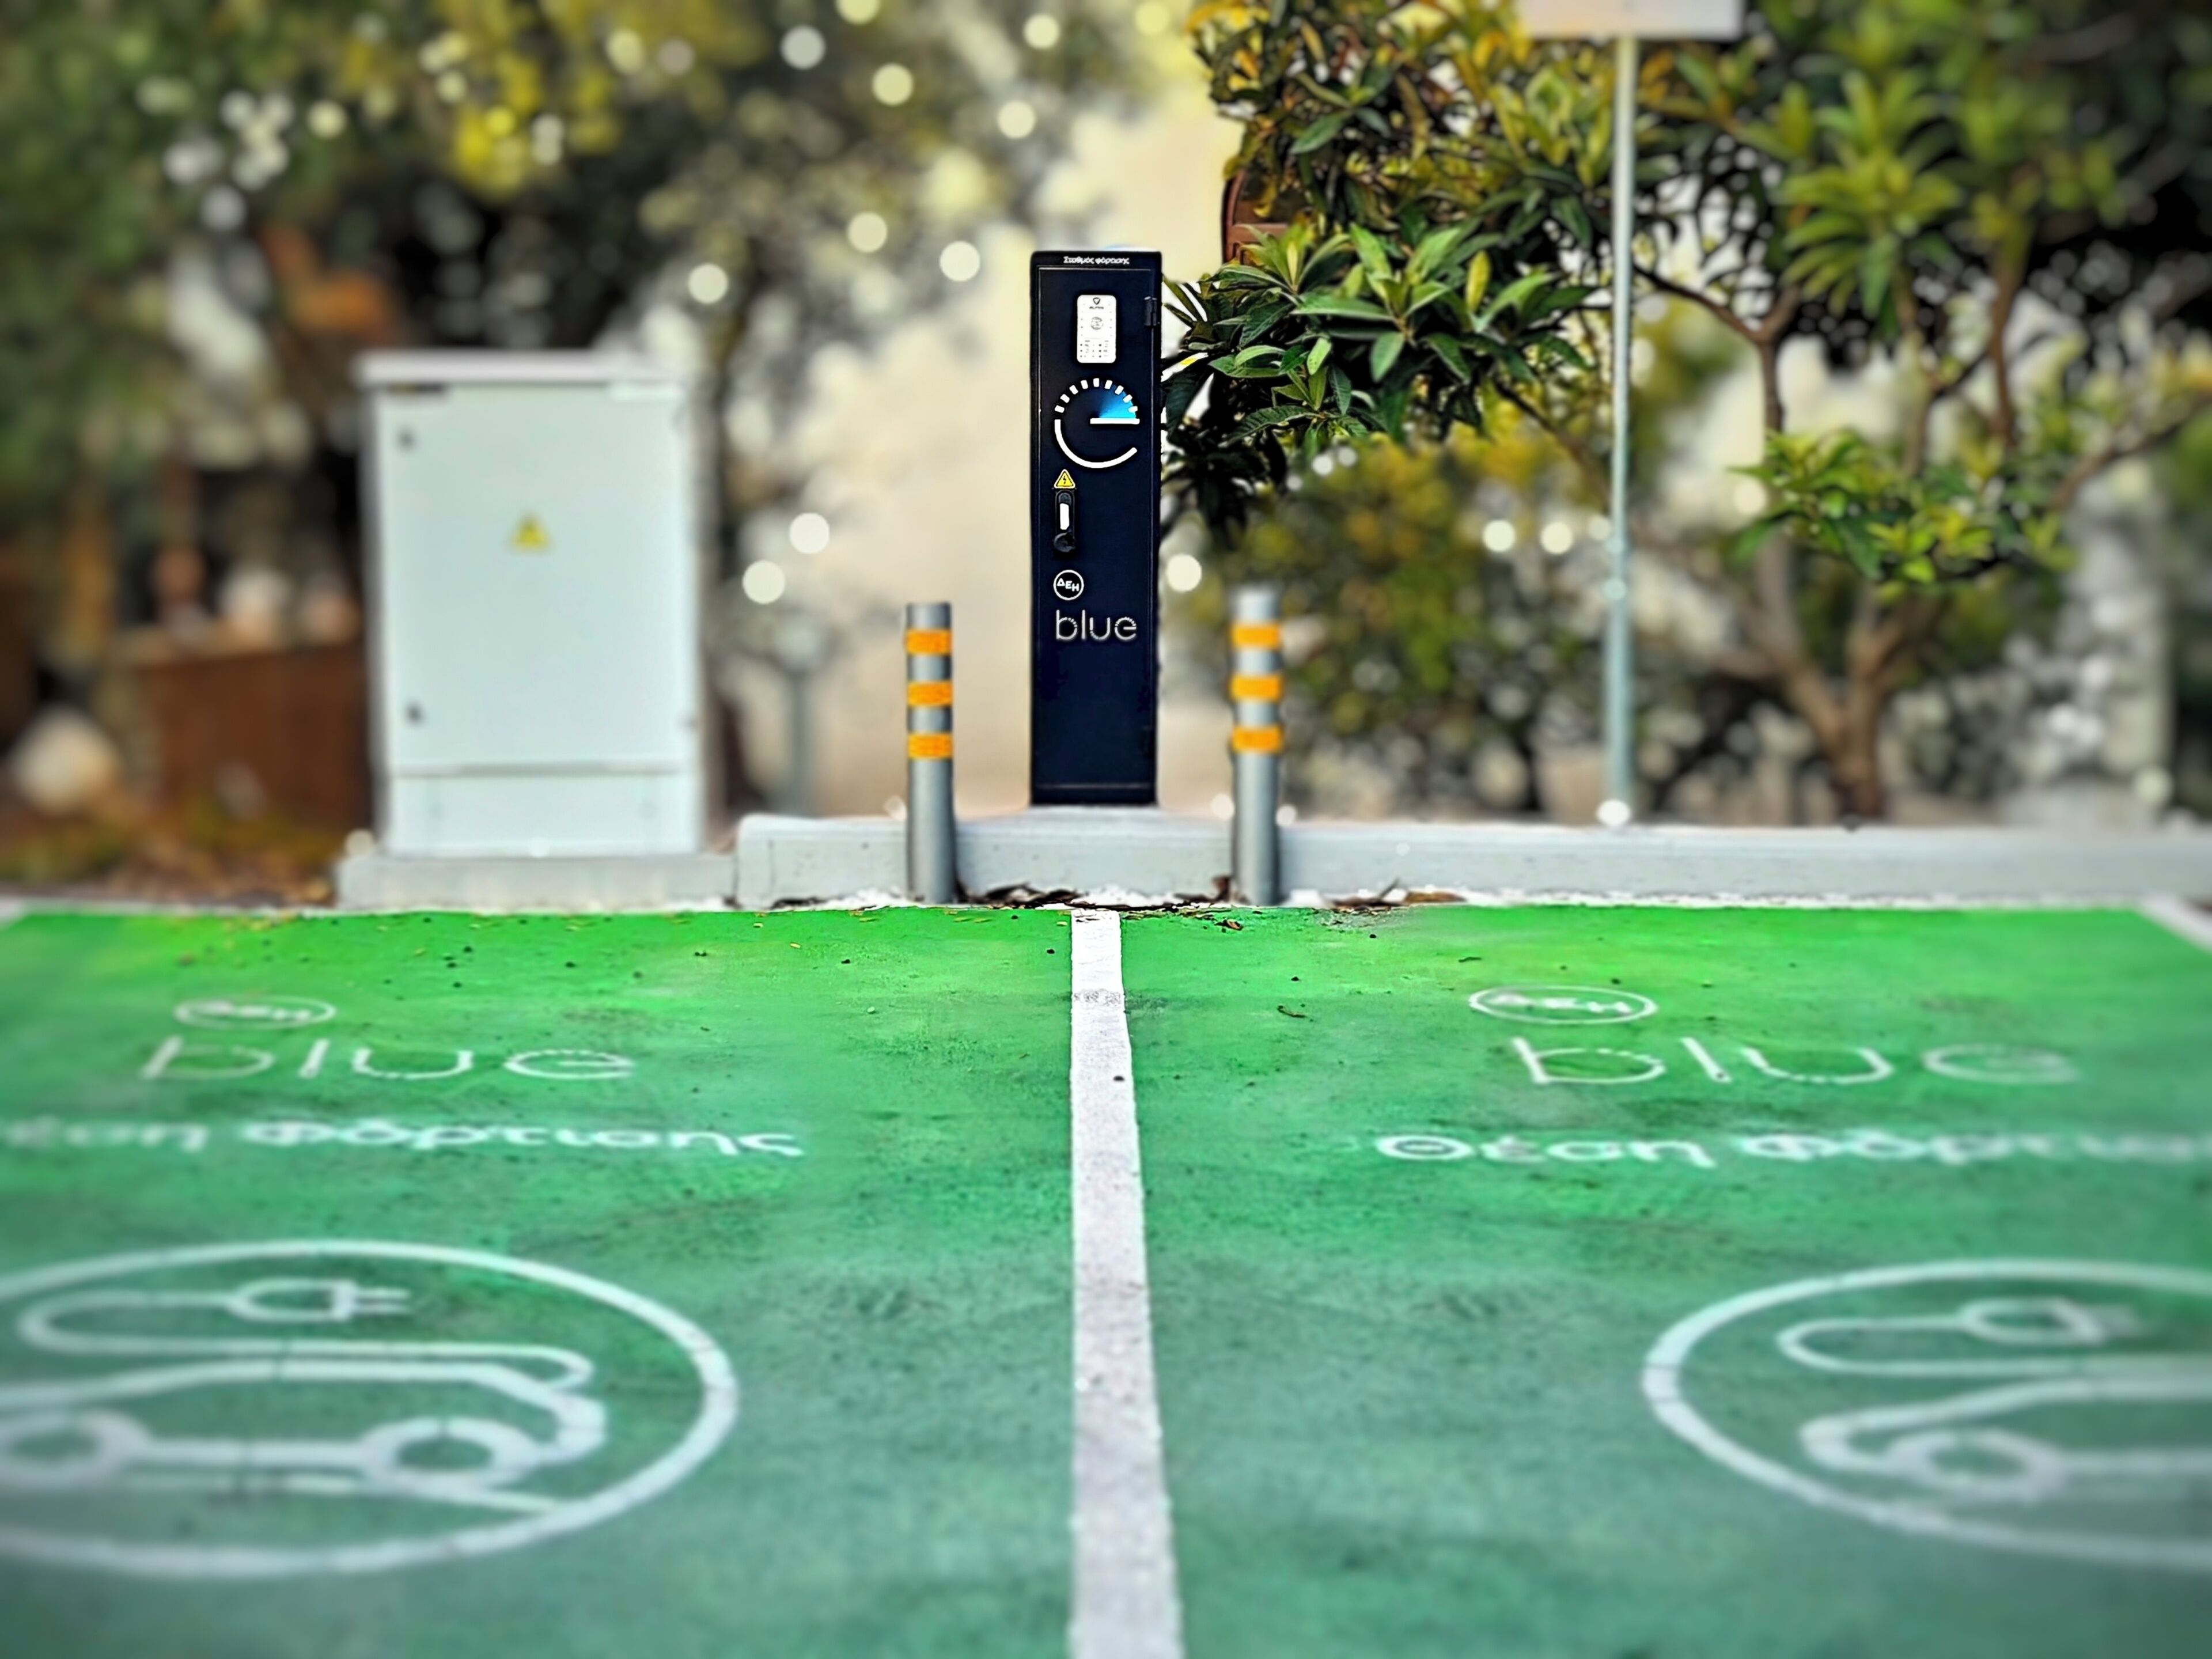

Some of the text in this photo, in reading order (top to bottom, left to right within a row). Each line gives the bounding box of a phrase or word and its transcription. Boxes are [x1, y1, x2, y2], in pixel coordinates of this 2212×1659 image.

[1056, 609, 1137, 640] blue
[140, 1036, 633, 1080] blue
[1512, 1036, 2081, 1084] blue
